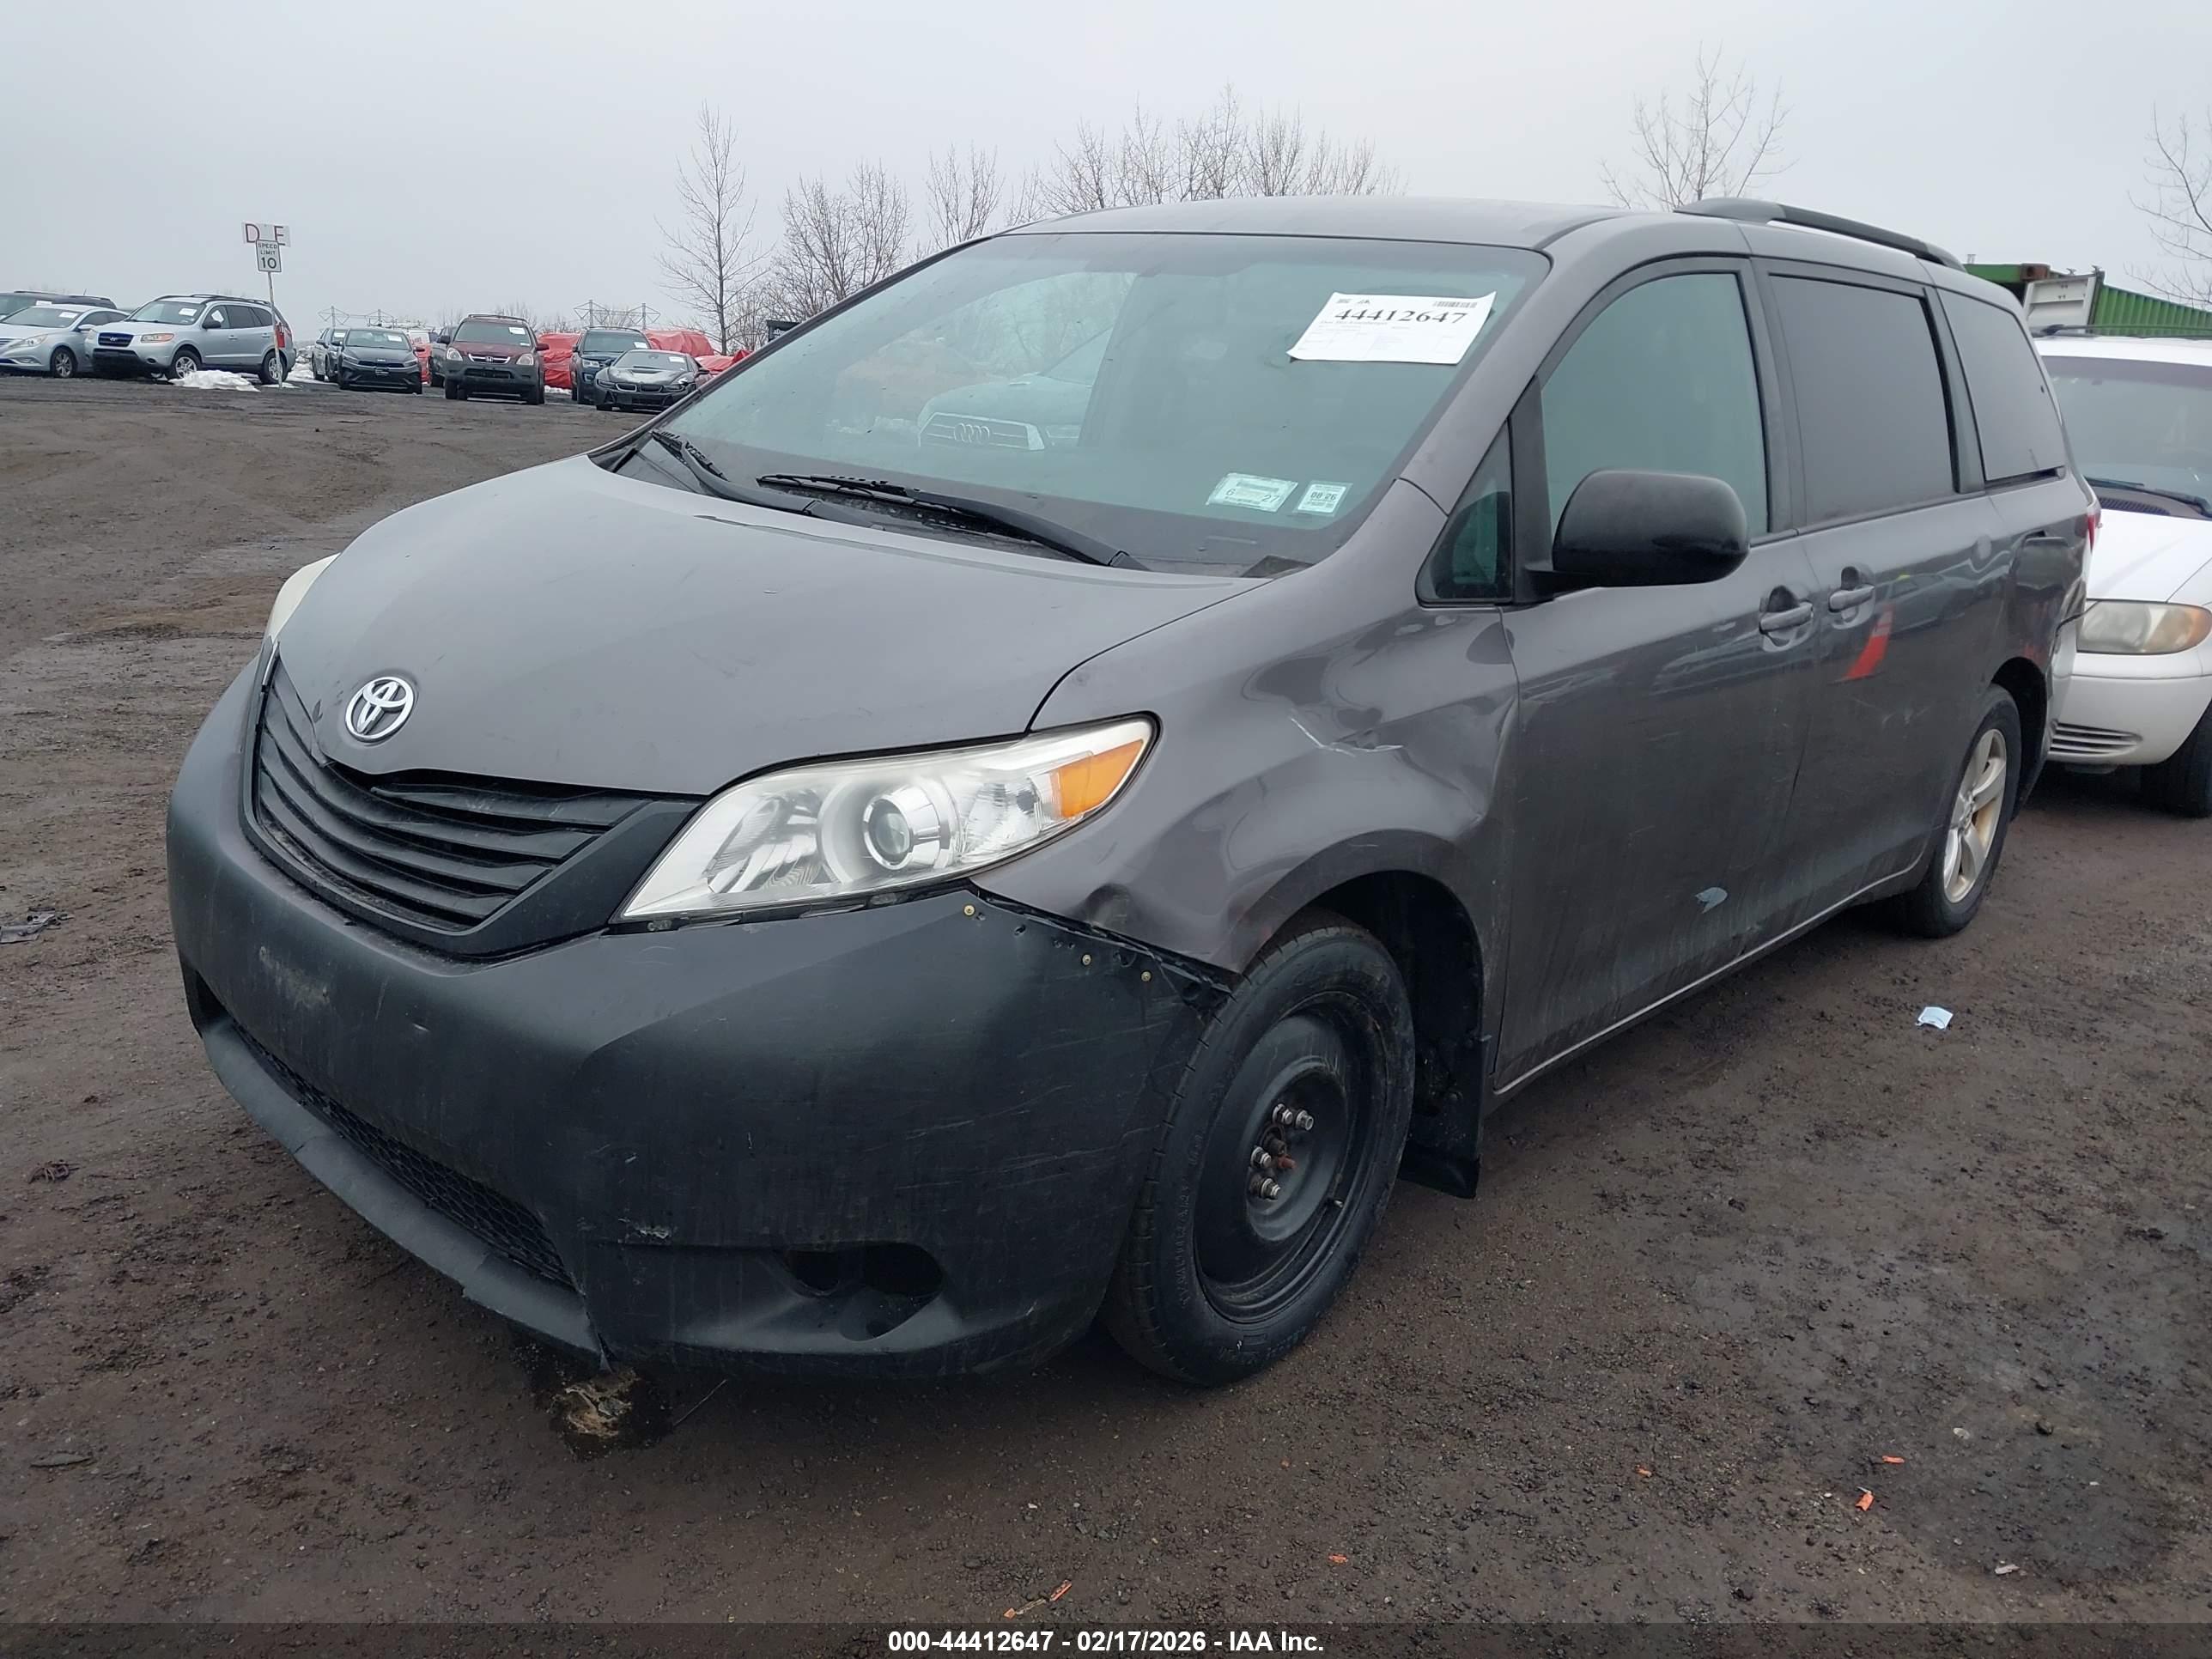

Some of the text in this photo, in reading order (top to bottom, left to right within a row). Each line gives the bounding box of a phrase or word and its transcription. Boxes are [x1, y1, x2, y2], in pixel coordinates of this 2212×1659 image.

[246, 223, 286, 246] D E
[261, 257, 277, 269] 10
[1334, 308, 1468, 324] 44412647
